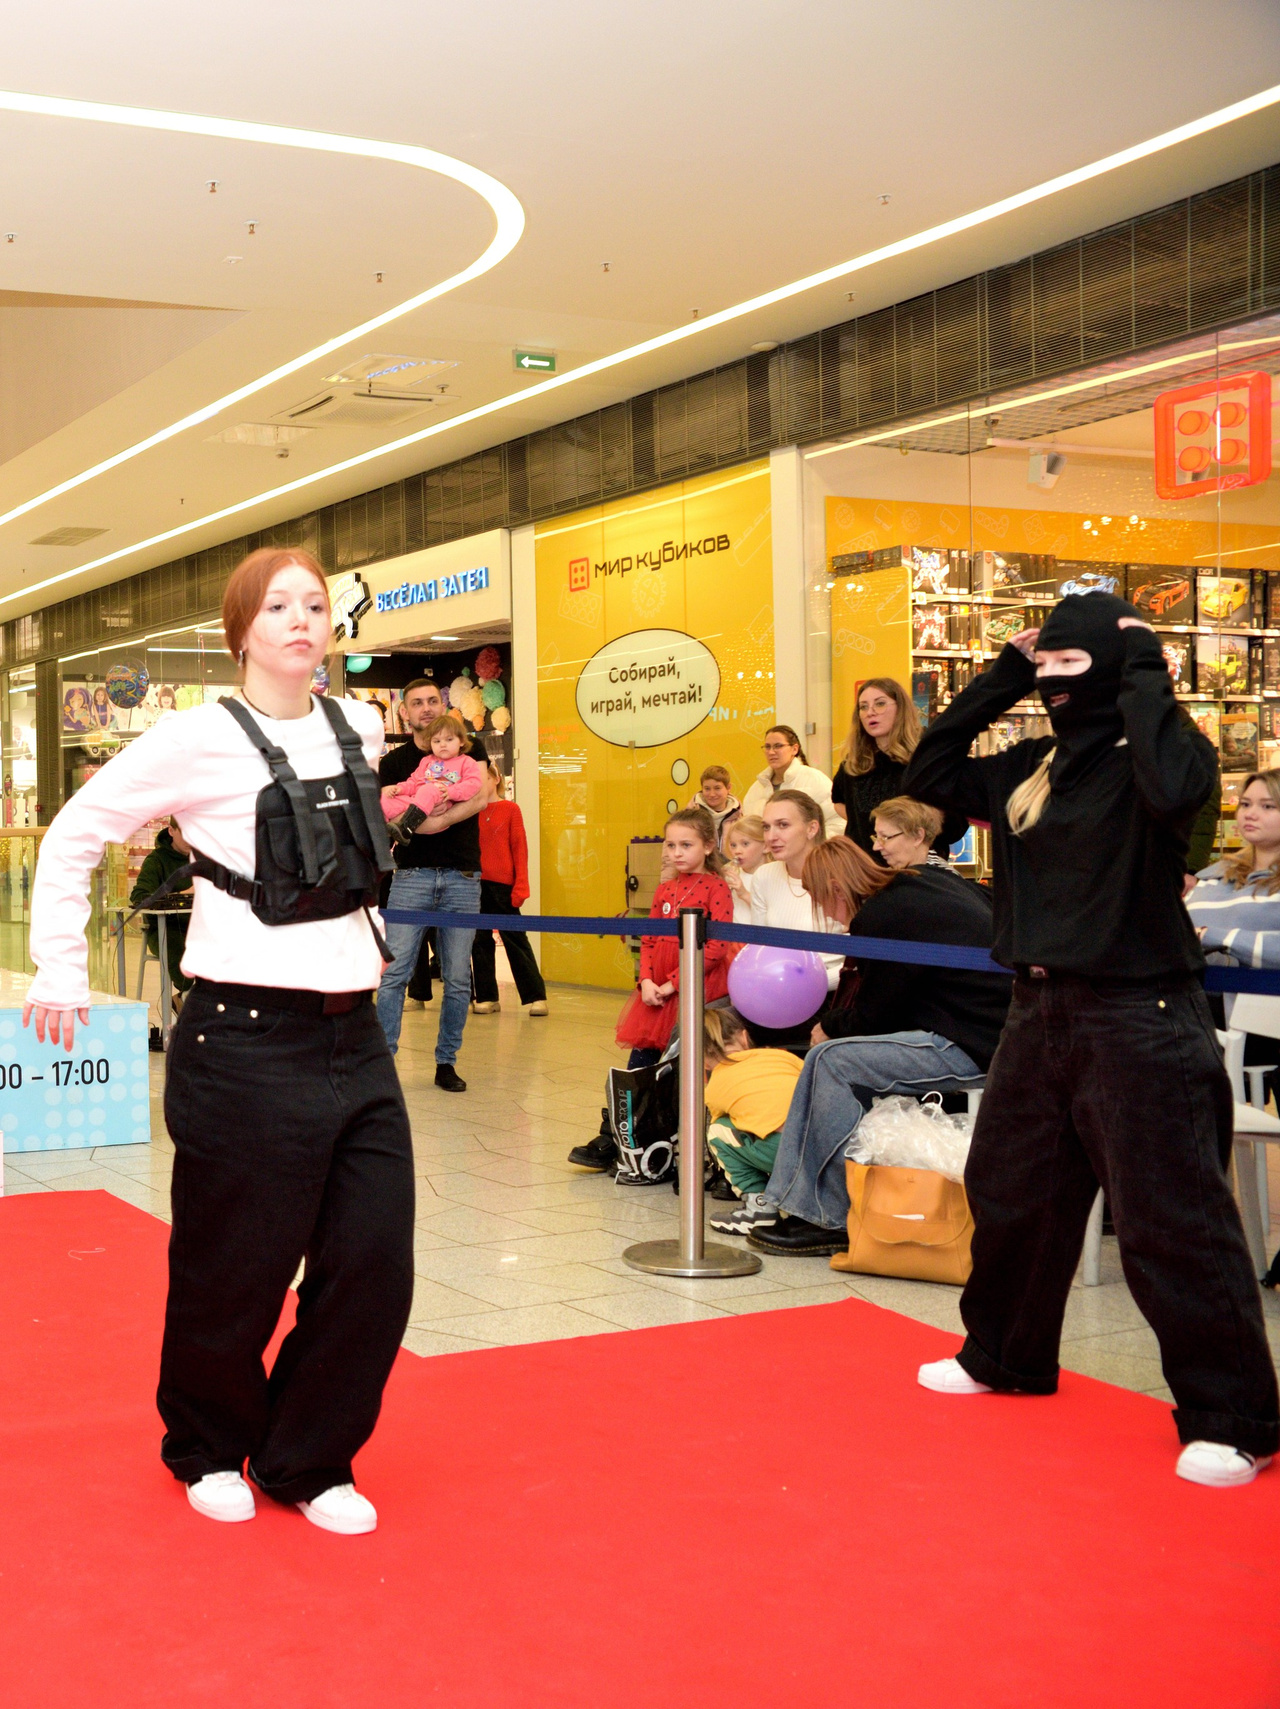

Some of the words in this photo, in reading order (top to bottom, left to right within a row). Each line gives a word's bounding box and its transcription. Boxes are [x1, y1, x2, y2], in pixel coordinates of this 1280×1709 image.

[375, 580, 438, 613] ВЕСЁЛАЯ
[439, 566, 489, 598] ЗАТЕЯ
[608, 655, 681, 684] Собирай,
[591, 690, 637, 716] играй,
[641, 683, 703, 709] мечтай!
[51, 1058, 110, 1087] 17:00
